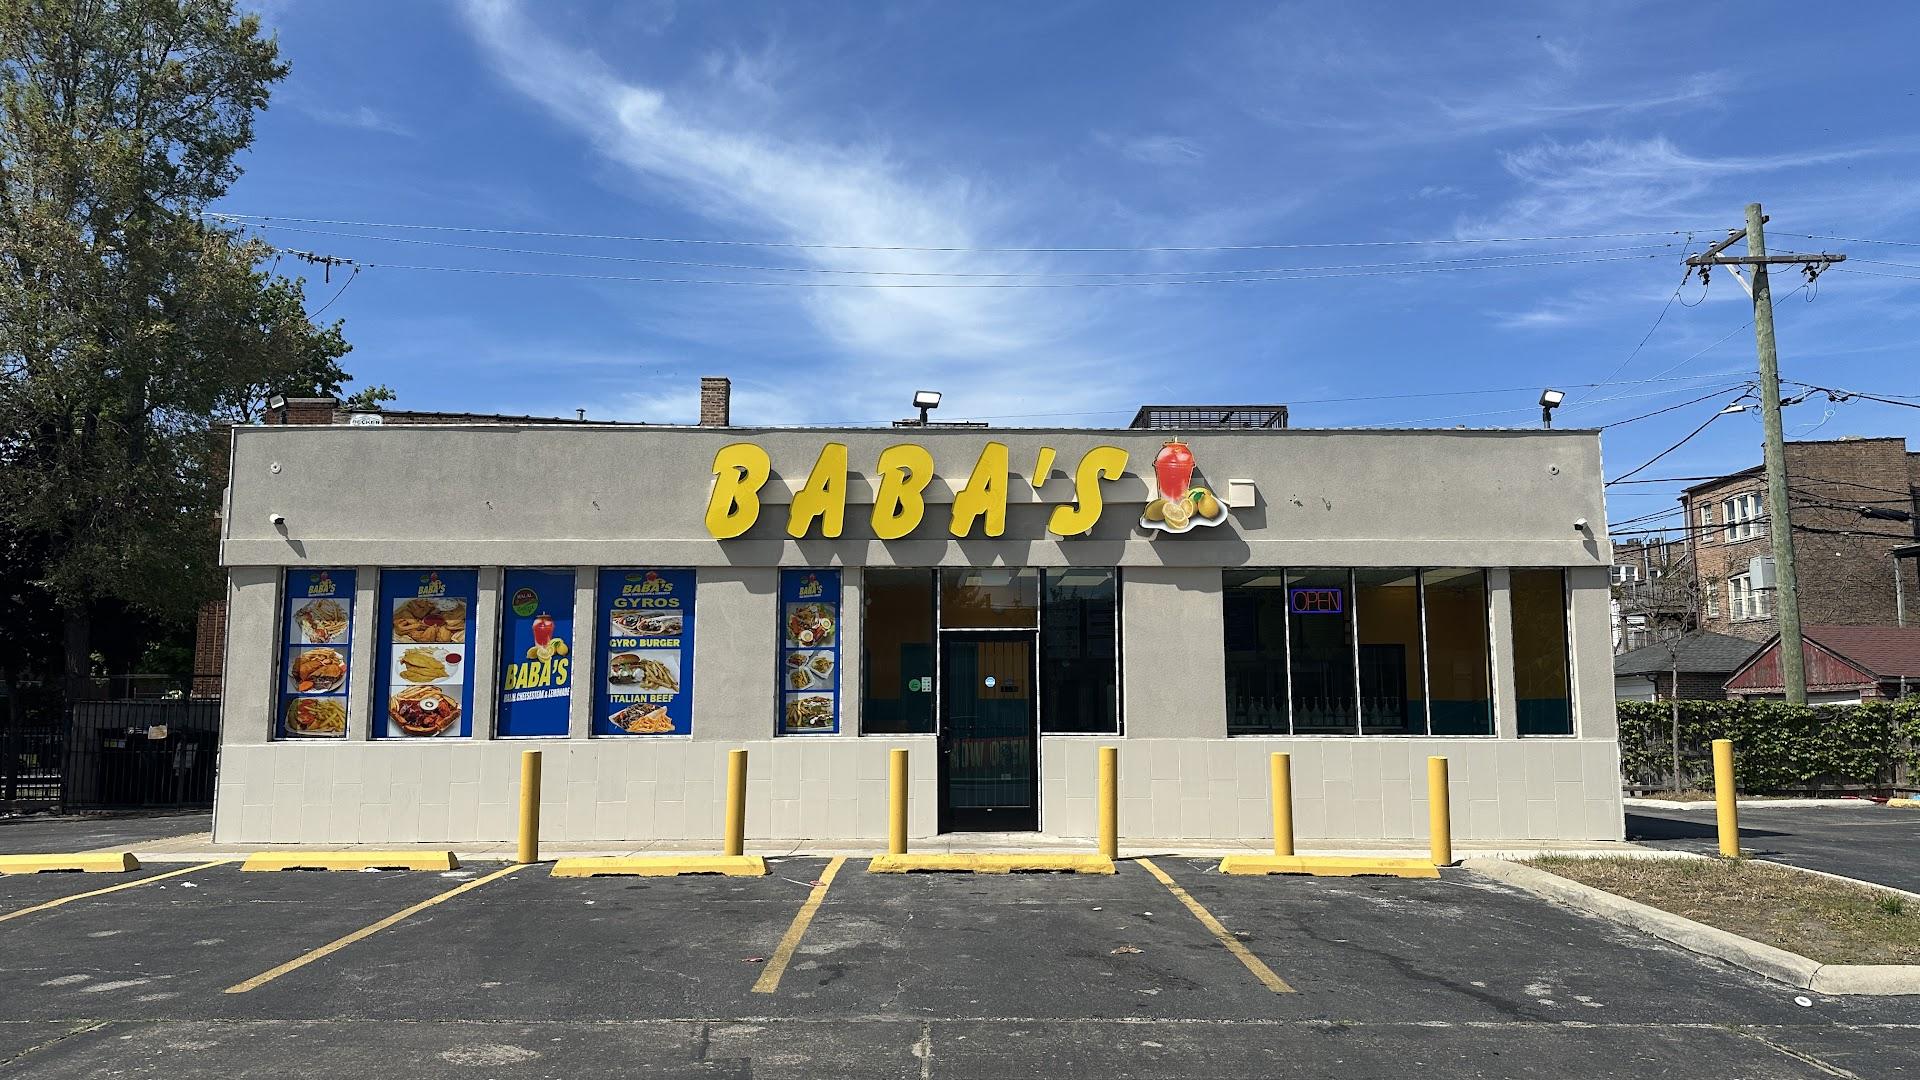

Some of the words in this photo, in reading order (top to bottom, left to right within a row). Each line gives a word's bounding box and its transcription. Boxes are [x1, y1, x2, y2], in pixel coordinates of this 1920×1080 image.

[705, 441, 1129, 539] BABA'S
[308, 584, 336, 593] BABA'S
[622, 583, 673, 593] BABA'S
[614, 597, 680, 608] GYROS
[1293, 591, 1340, 611] OPEN
[610, 639, 637, 648] GYRO
[640, 639, 680, 648] BURGER
[504, 658, 569, 691] BABA'S
[610, 694, 647, 703] ITALIAN
[650, 694, 674, 703] BEEF
